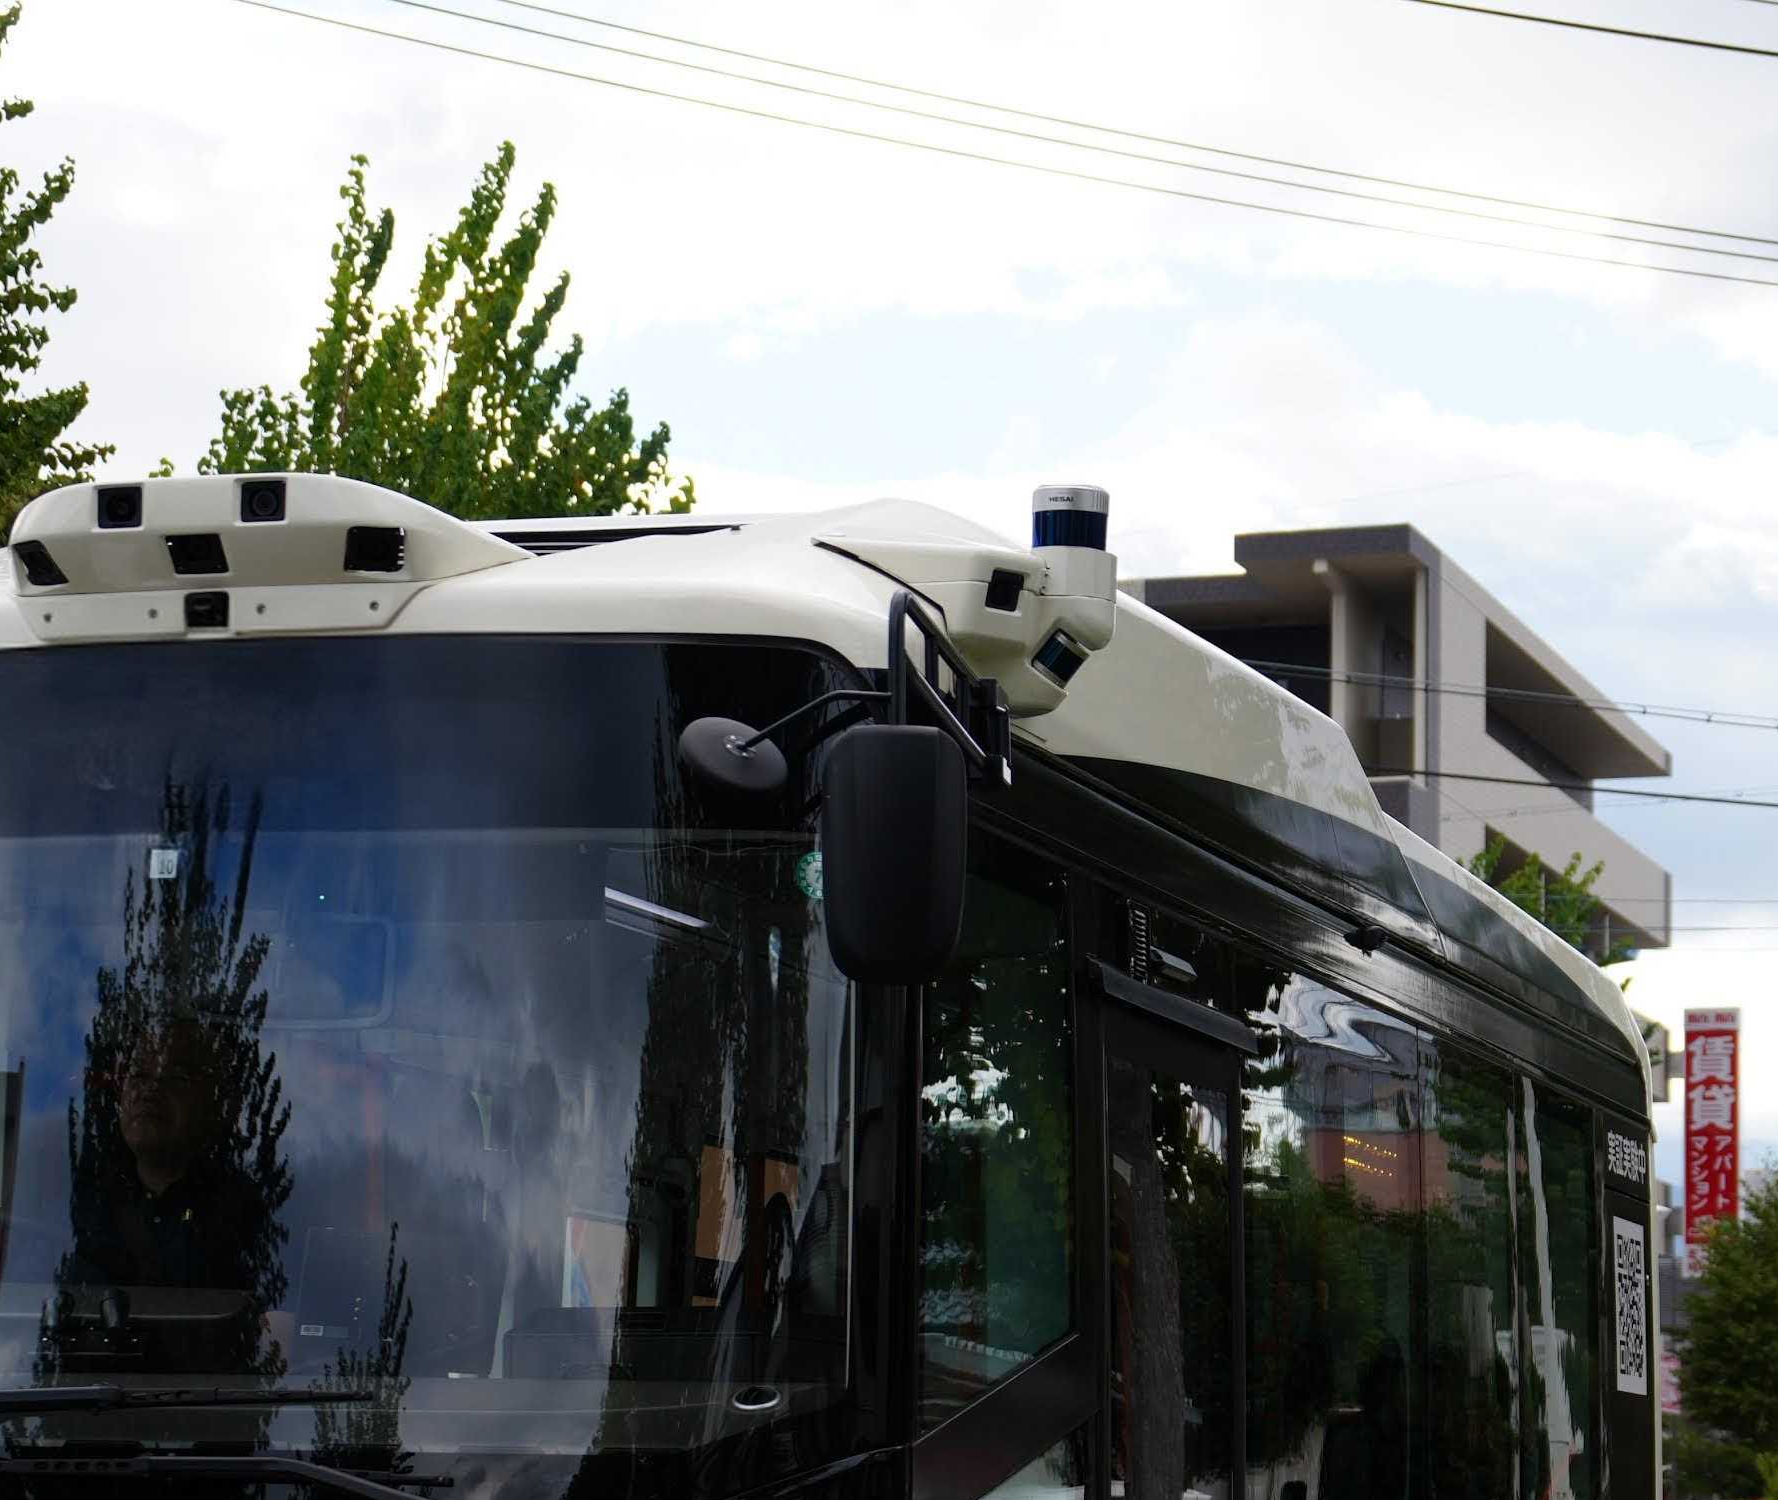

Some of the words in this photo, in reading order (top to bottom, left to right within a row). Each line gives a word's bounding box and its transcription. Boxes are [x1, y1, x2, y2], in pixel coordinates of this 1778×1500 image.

[1688, 1035, 1735, 1131] 賃貸
[1607, 1129, 1646, 1185] 実証実験中
[1690, 1135, 1711, 1211] マンション
[1713, 1135, 1733, 1210] アパート
